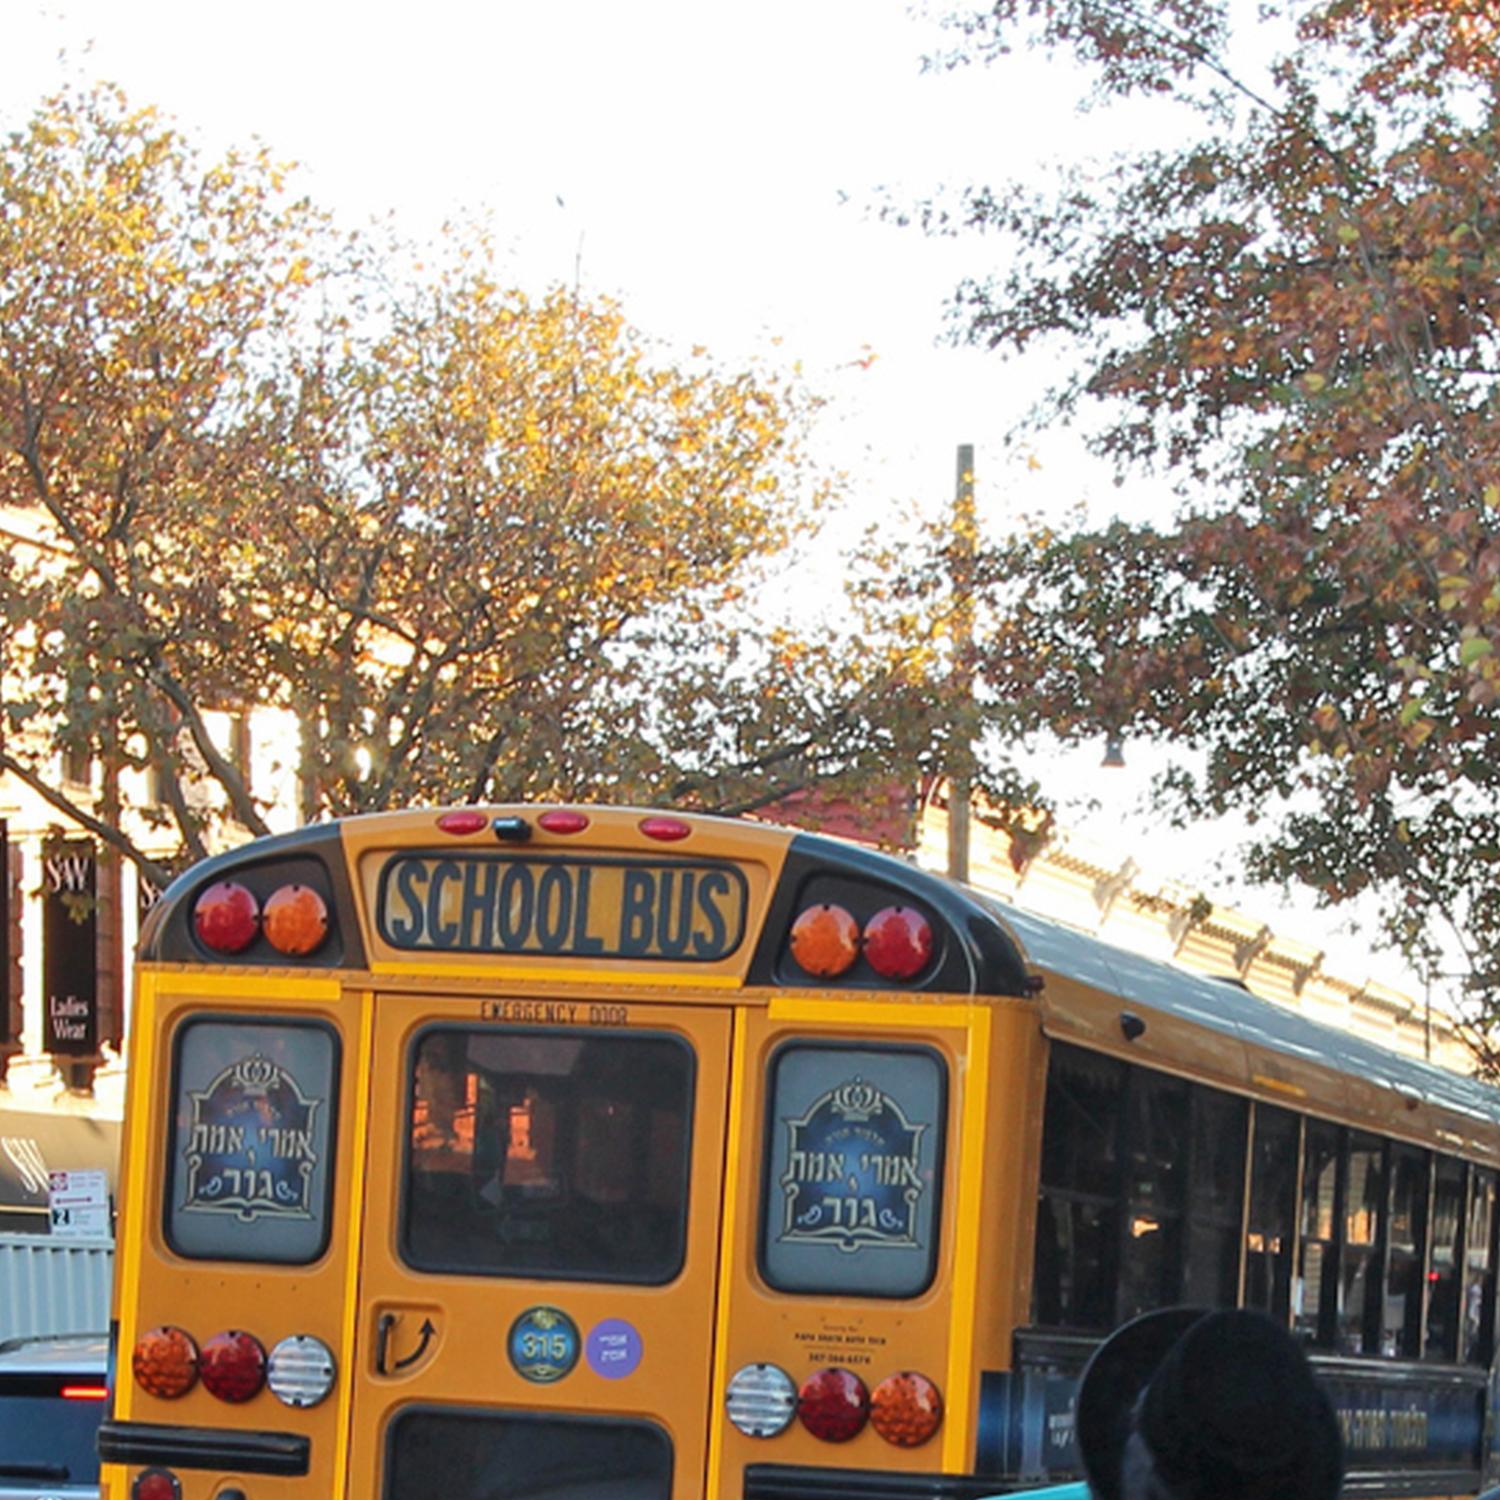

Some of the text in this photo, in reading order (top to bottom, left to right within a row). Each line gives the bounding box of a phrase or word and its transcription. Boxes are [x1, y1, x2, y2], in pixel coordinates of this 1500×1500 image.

[392, 859, 730, 955] SCHOOL BUS
[51, 995, 89, 1017] Ladies
[480, 1000, 628, 1026] EMERGENCY DOOR
[52, 1019, 86, 1039] Wear
[223, 1167, 272, 1198] גור
[822, 1197, 876, 1227] גור
[523, 1332, 566, 1359] 315
